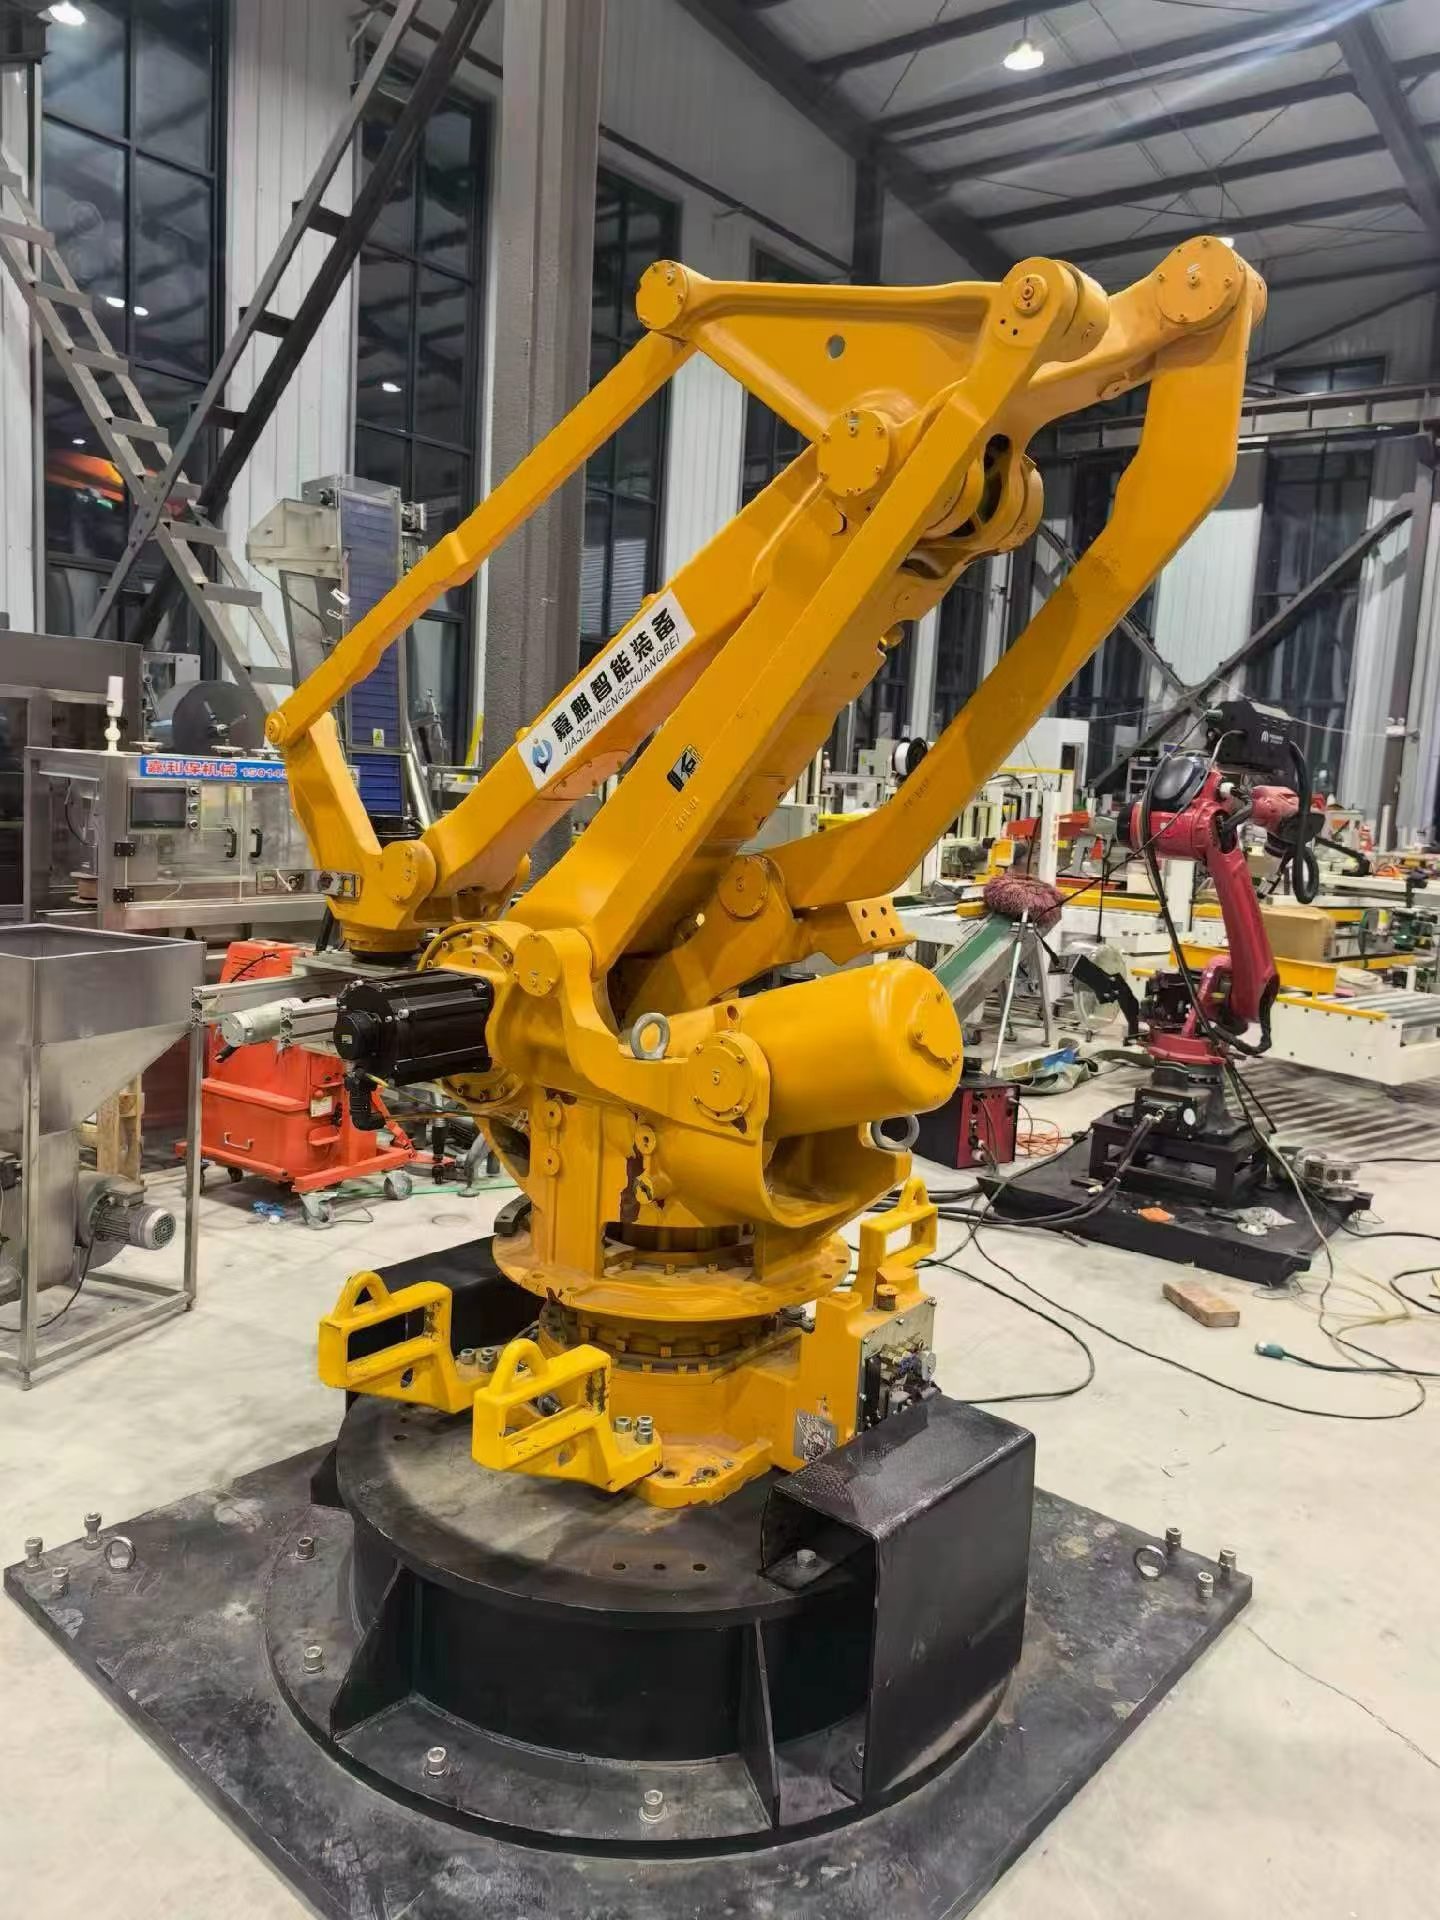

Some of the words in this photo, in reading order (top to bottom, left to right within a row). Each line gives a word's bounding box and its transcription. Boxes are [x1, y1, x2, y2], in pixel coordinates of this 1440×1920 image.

[551, 608, 675, 741] 嘉麒智能装备
[564, 633, 680, 755] JIAQIZHINENGZHUANGBEI
